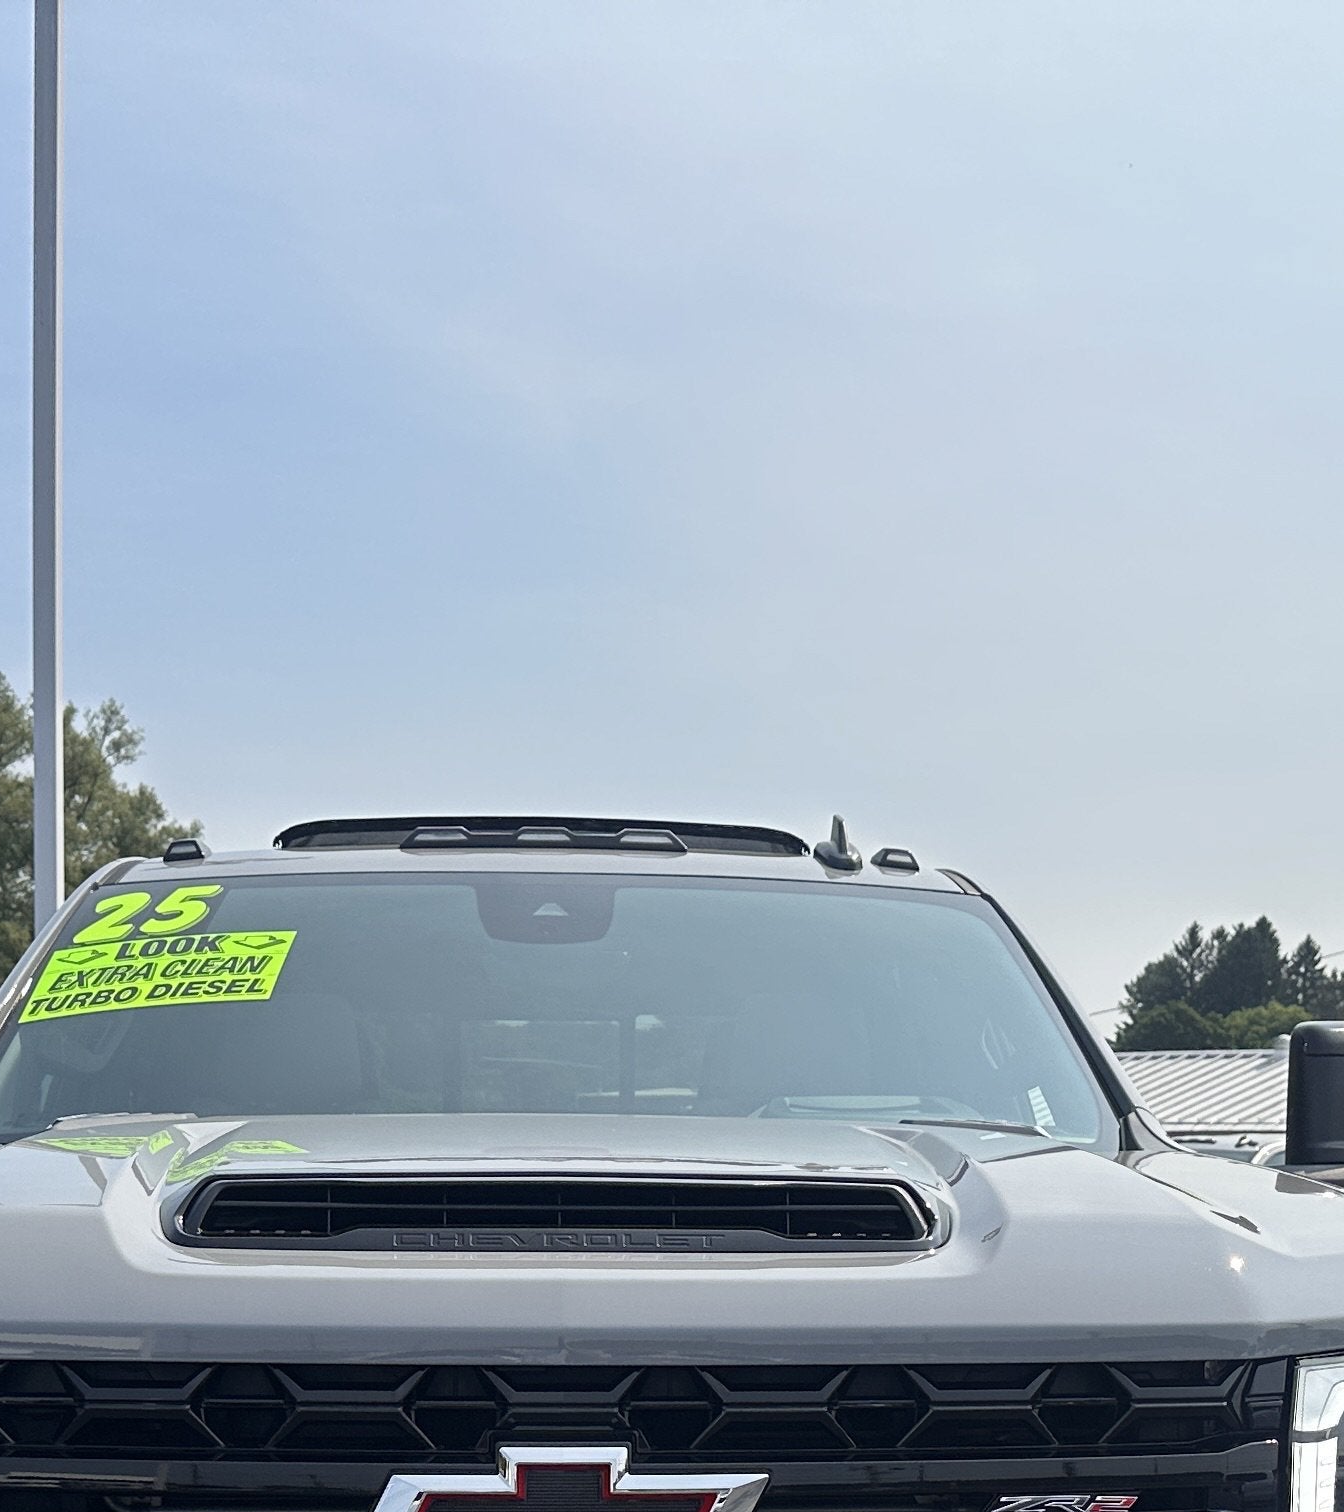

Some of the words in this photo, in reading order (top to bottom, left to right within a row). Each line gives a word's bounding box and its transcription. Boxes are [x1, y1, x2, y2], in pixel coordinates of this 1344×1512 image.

[73, 884, 224, 945] 25
[115, 935, 231, 961] LOOK
[49, 961, 157, 994] EXTRA
[160, 955, 272, 978] CLEAN
[28, 987, 140, 1016] TURBO
[145, 978, 267, 1002] DIESEL
[392, 1232, 726, 1249] CHEVROLET
